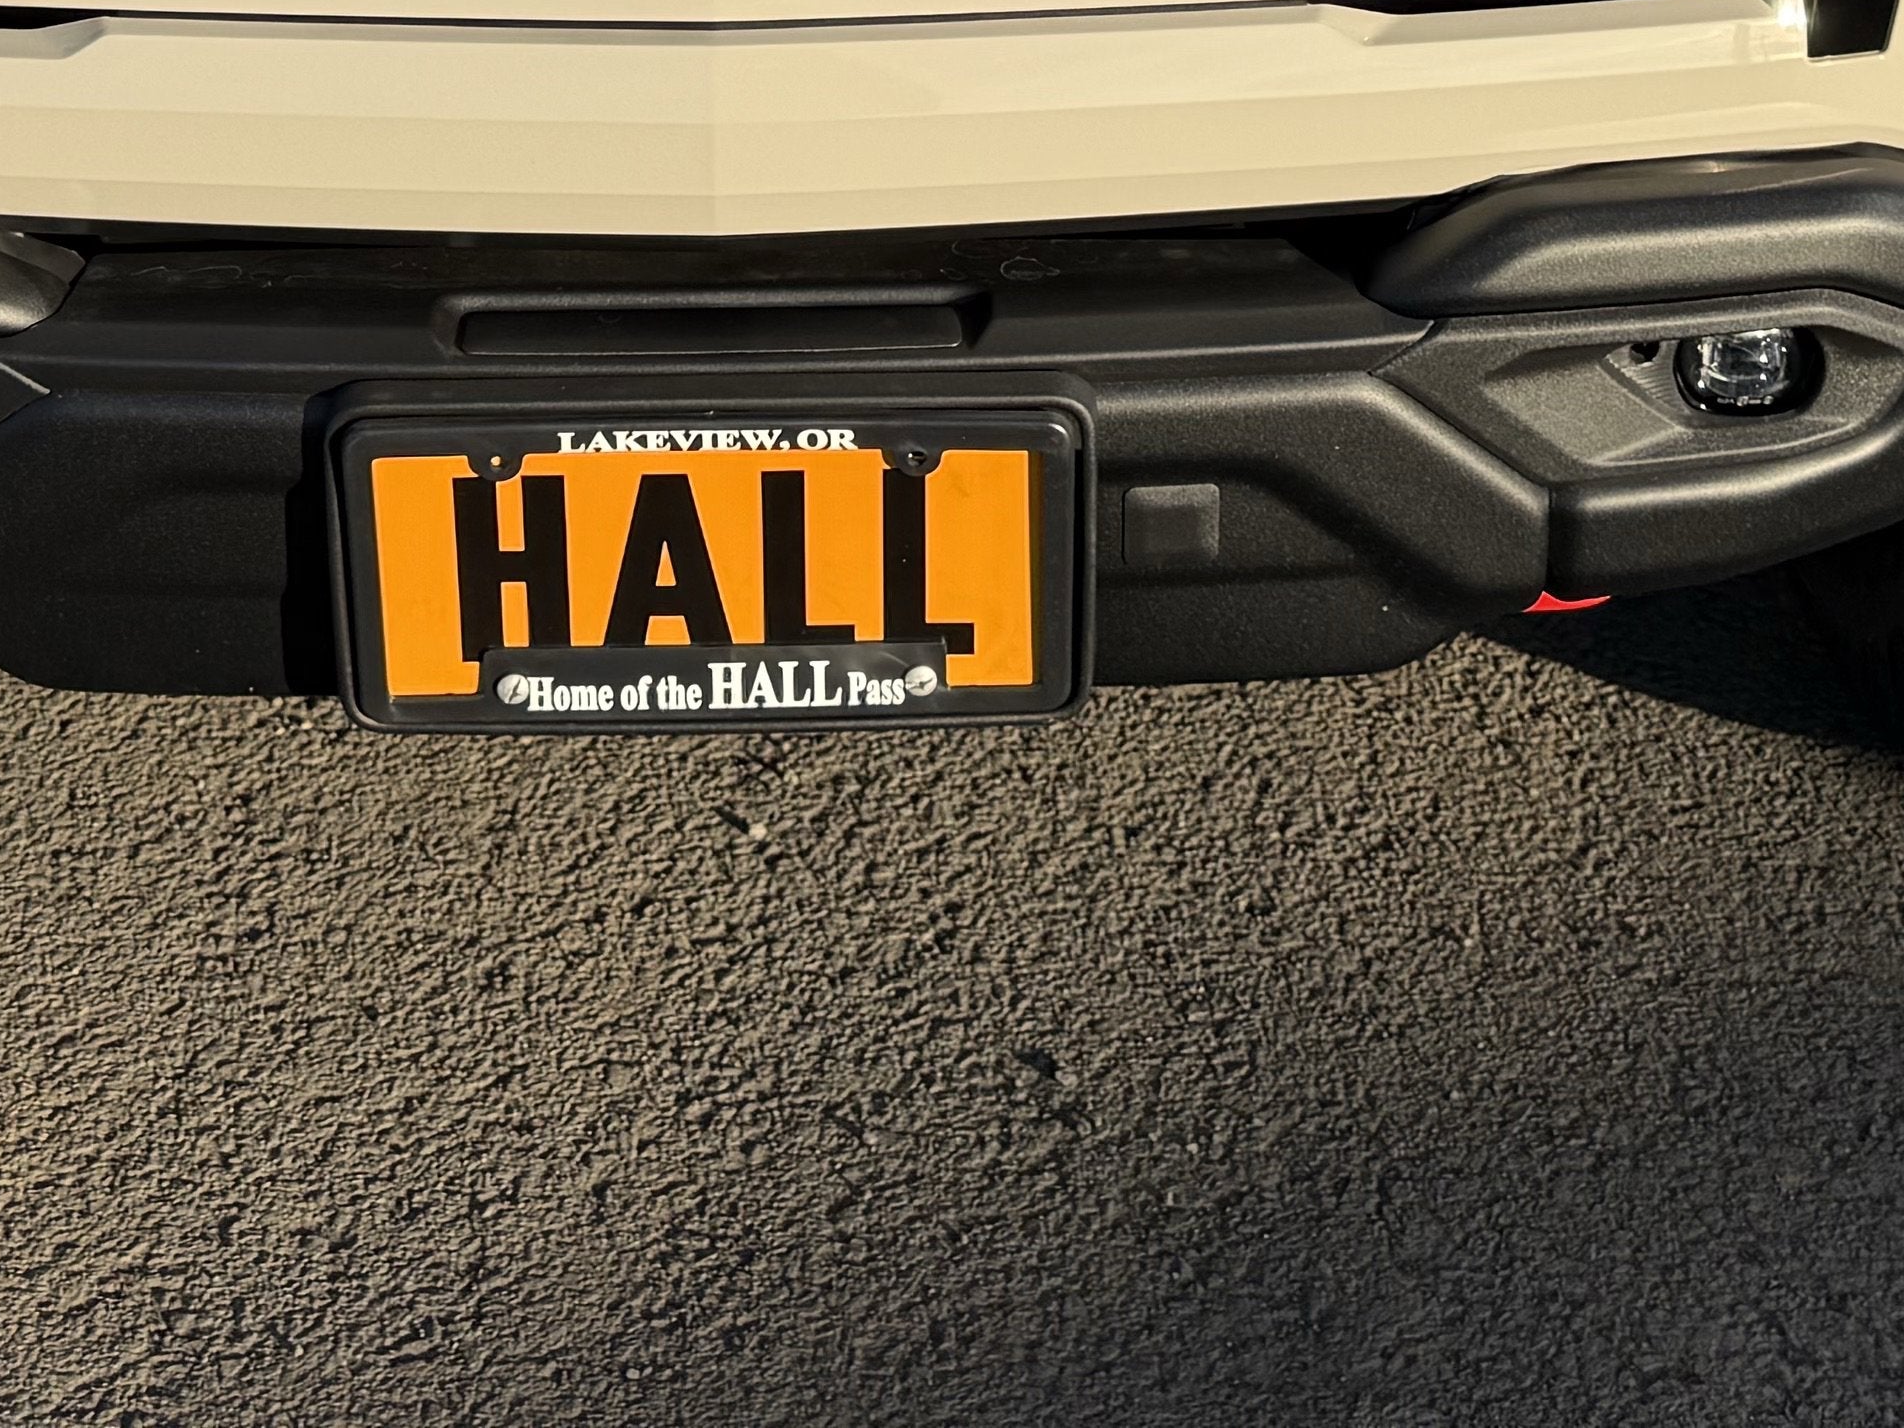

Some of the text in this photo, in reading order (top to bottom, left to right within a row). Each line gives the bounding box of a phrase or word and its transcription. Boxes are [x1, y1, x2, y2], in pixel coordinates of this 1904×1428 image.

[557, 428, 859, 453] LAKEVIEW, OR
[452, 469, 975, 662] HALL
[527, 660, 907, 712] Home of the HALL Pass
